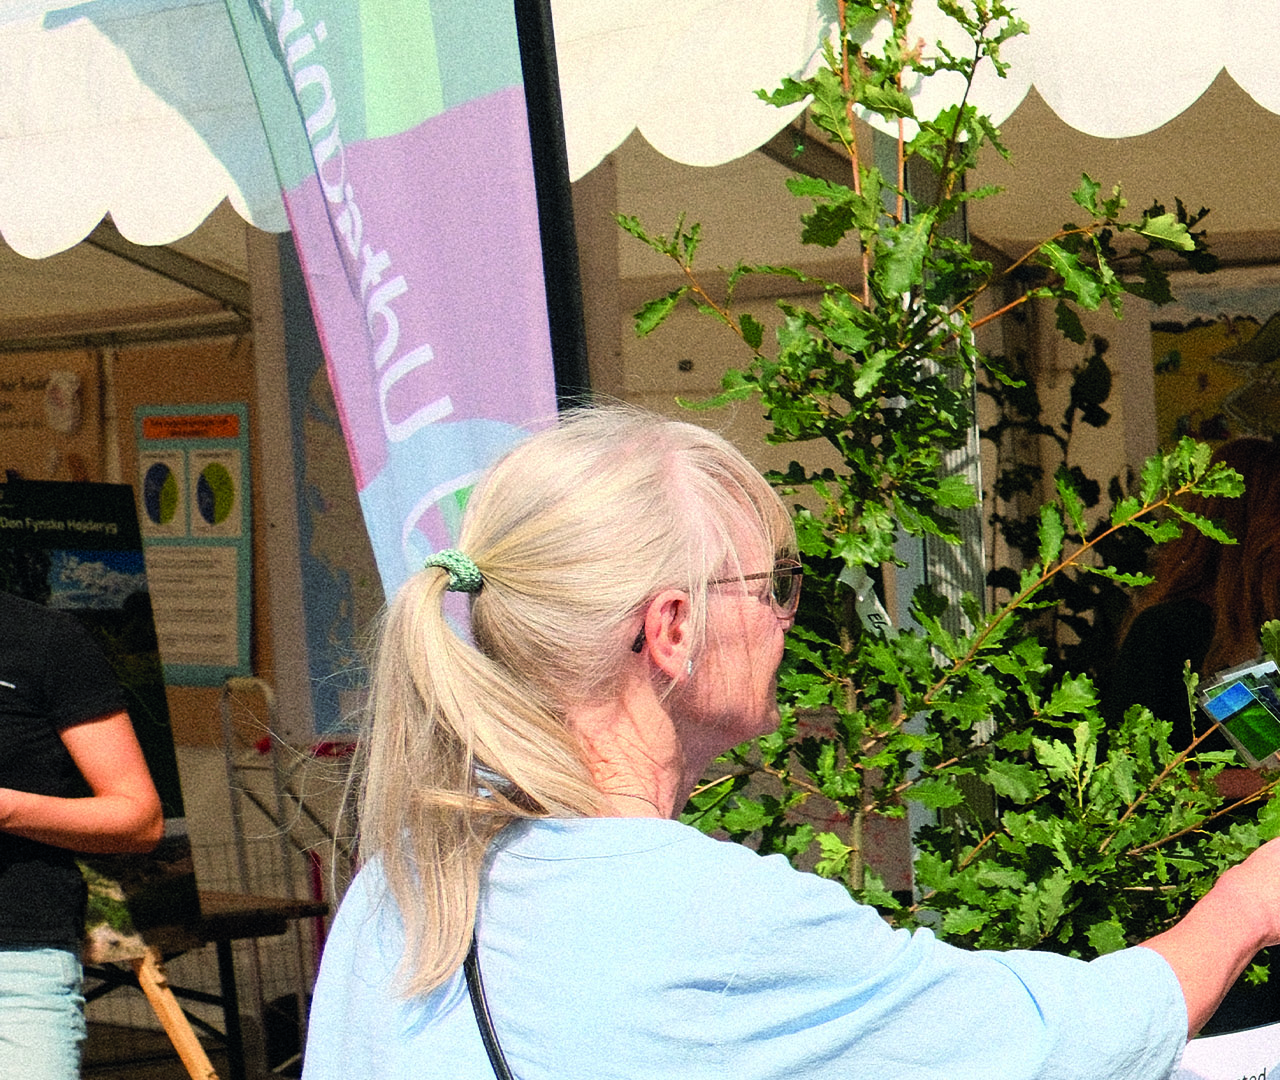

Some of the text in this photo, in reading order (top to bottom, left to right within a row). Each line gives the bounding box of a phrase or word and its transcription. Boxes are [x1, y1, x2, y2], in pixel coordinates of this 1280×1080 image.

[0, 517, 119, 536] Den Fynske Højderyg
